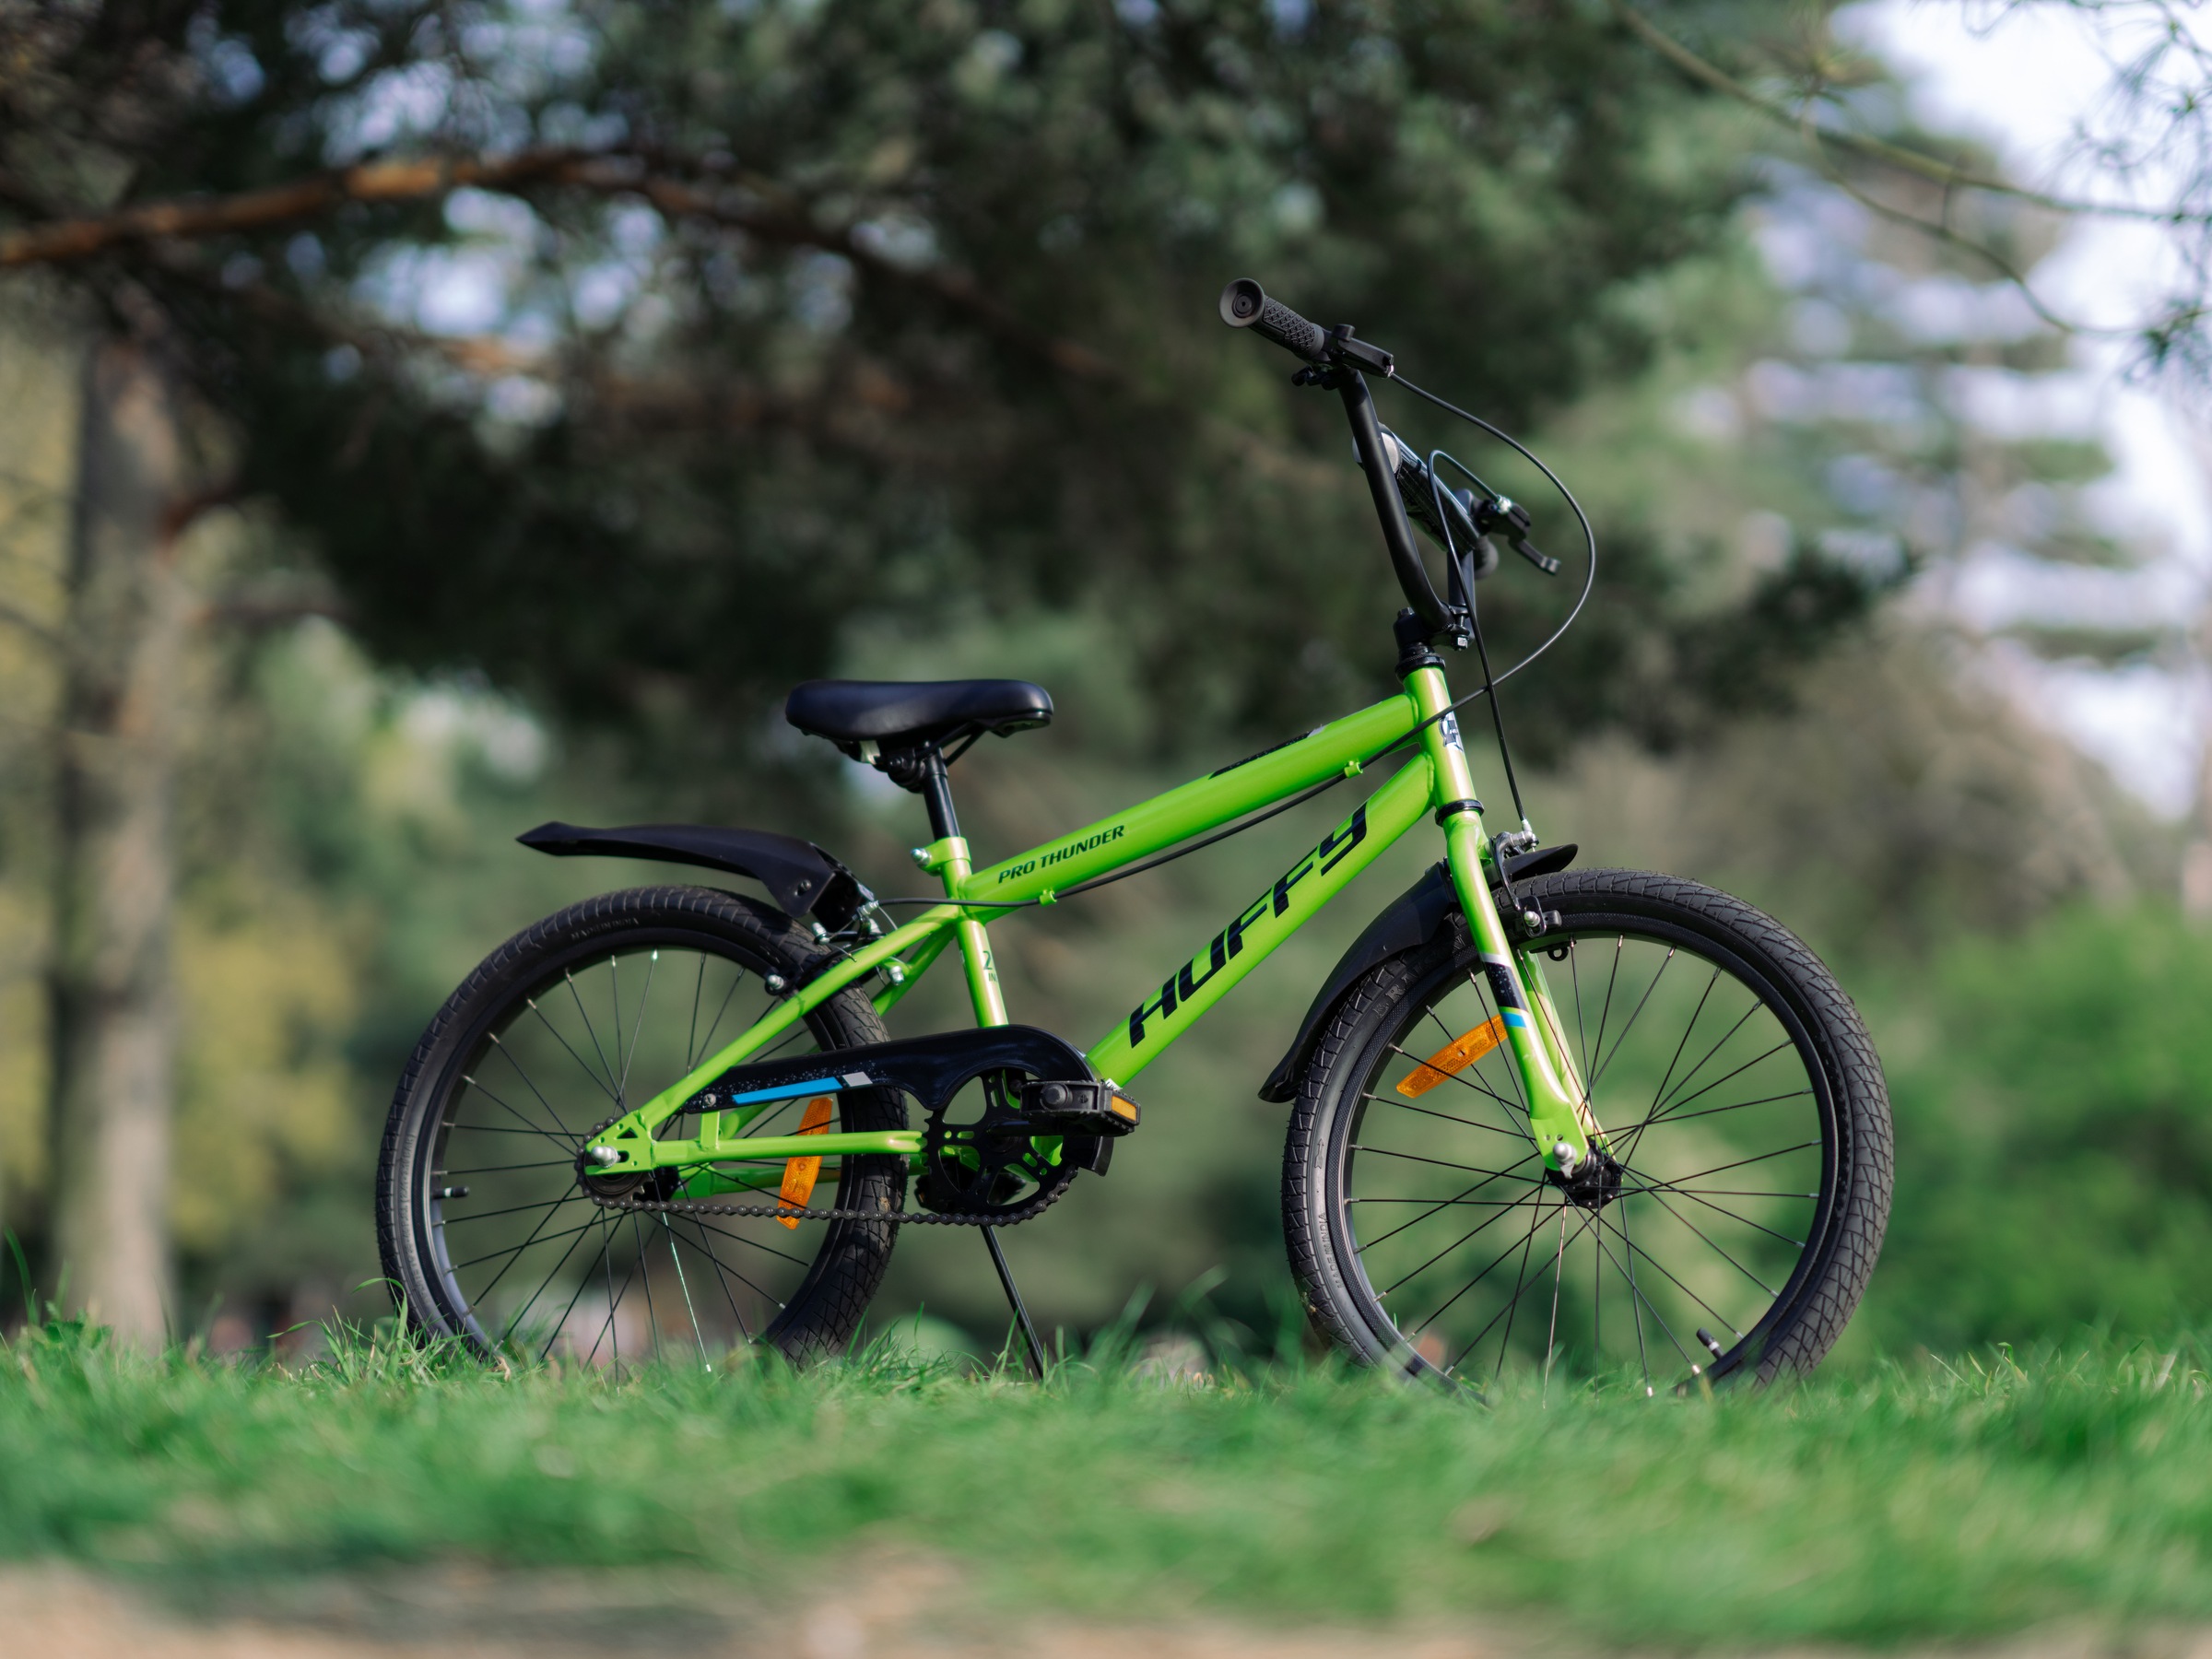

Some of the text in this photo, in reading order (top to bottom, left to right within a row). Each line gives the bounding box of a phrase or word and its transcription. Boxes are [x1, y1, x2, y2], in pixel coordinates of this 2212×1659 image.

[998, 825, 1125, 884] PRO THUNDER
[1129, 802, 1367, 1049] HUFFY
[1318, 1211, 1345, 1288] MADE IN INDIA
